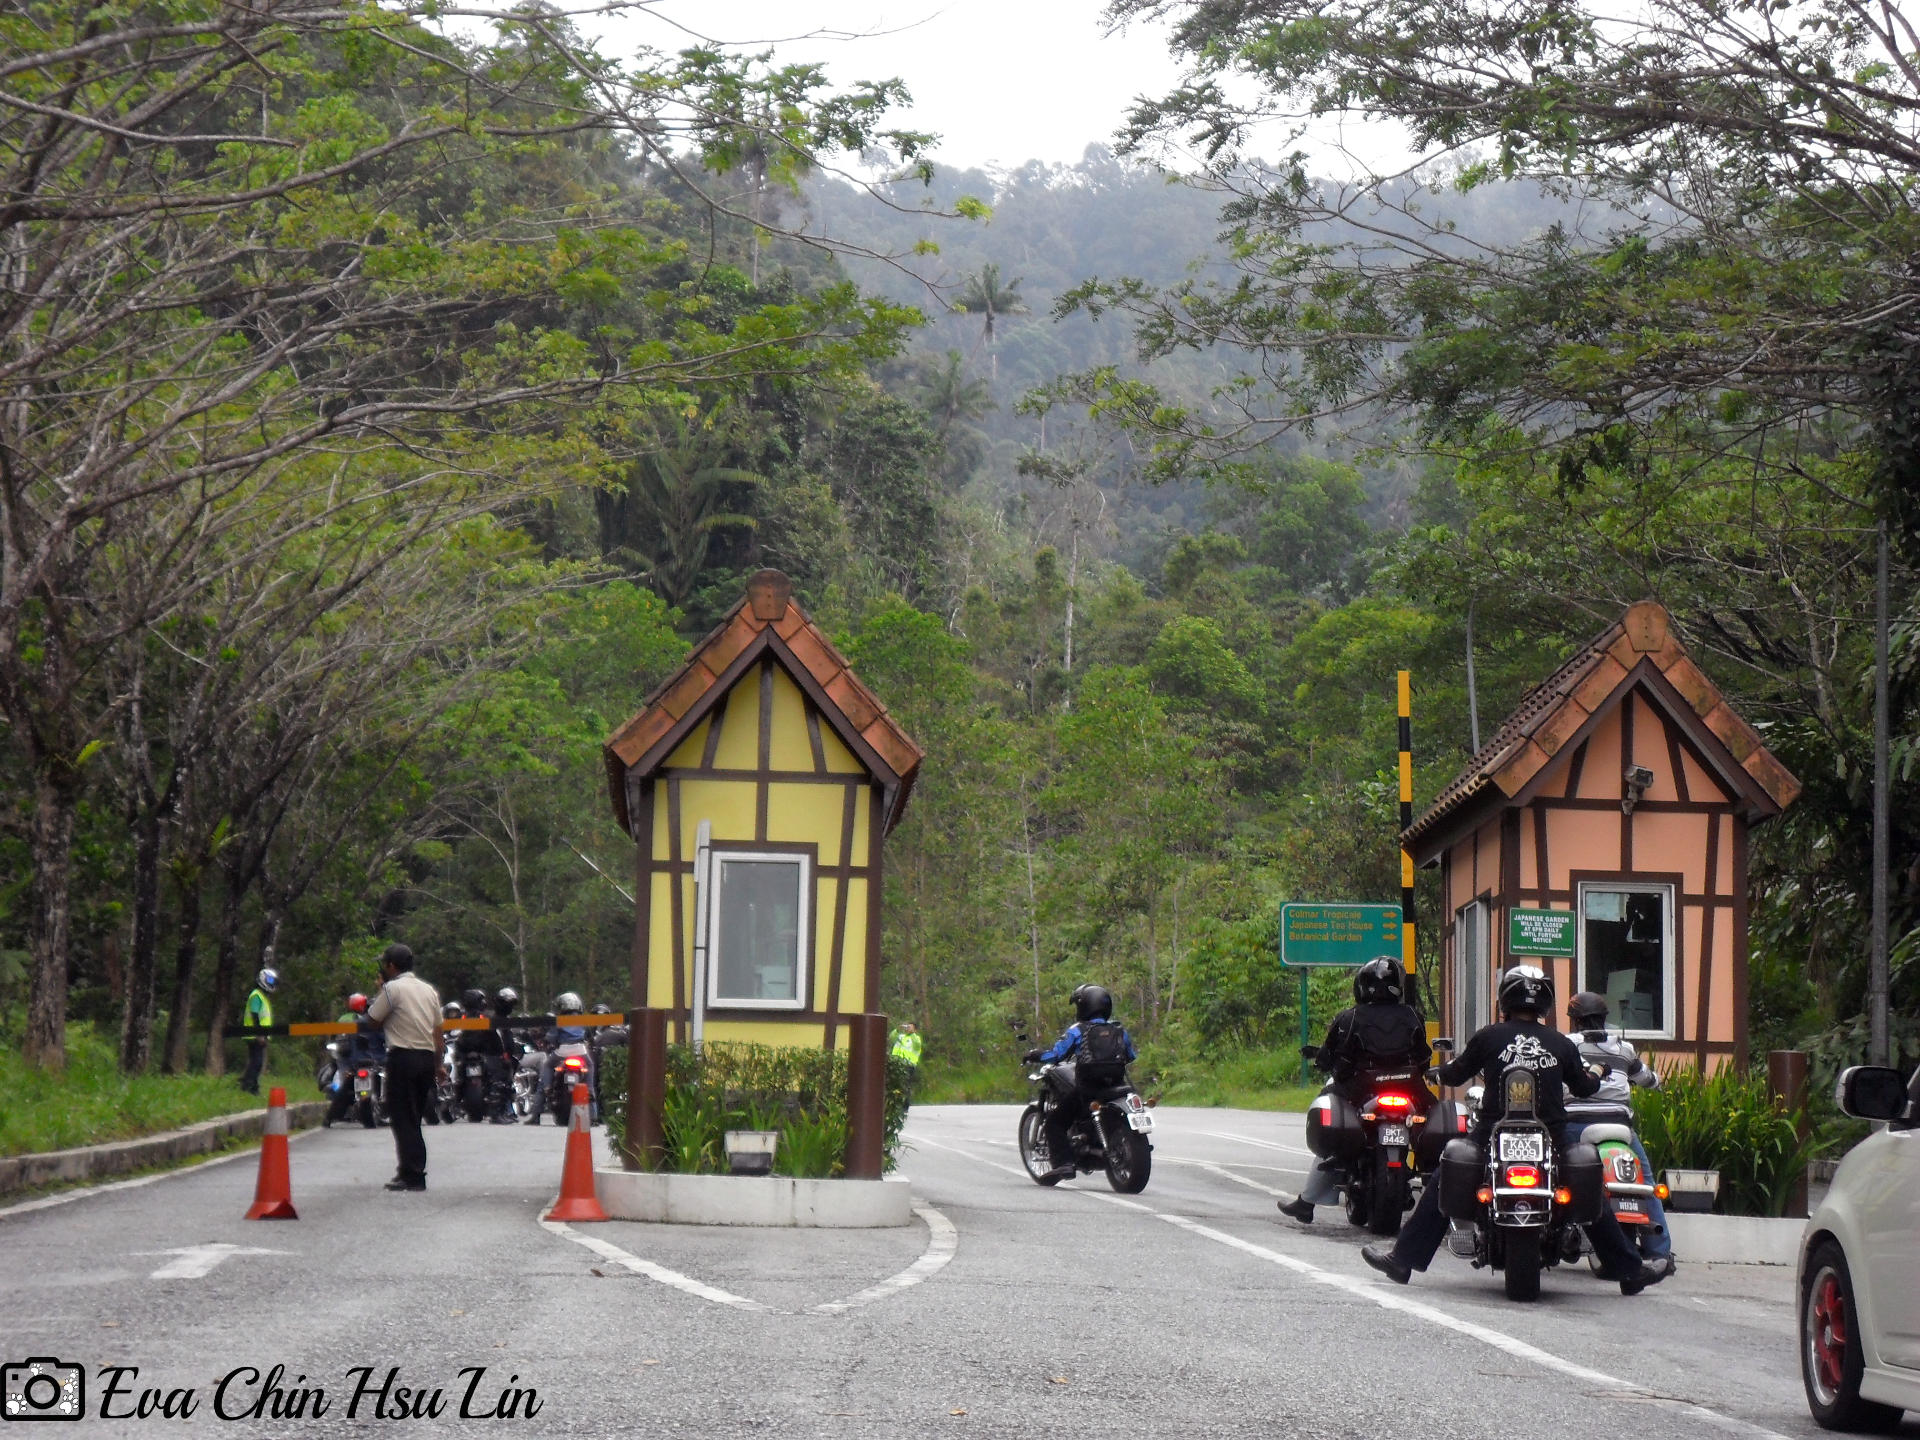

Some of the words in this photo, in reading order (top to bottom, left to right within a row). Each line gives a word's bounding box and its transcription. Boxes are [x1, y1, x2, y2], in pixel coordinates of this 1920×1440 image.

[1289, 909, 1319, 918] Colmar
[1322, 909, 1362, 919] Tropicale
[1289, 920, 1328, 930] Japanese
[1331, 920, 1346, 930] Tea
[1348, 921, 1374, 930] House
[1289, 931, 1329, 941] Botanical
[1331, 931, 1362, 941] Garden
[1498, 1049, 1512, 1063] All
[1513, 1054, 1539, 1069] Bikers
[1539, 1055, 1558, 1069] Club
[1383, 1135, 1404, 1143] 8442
[1510, 1140, 1532, 1149] KAX
[1507, 1148, 1537, 1157] 9009
